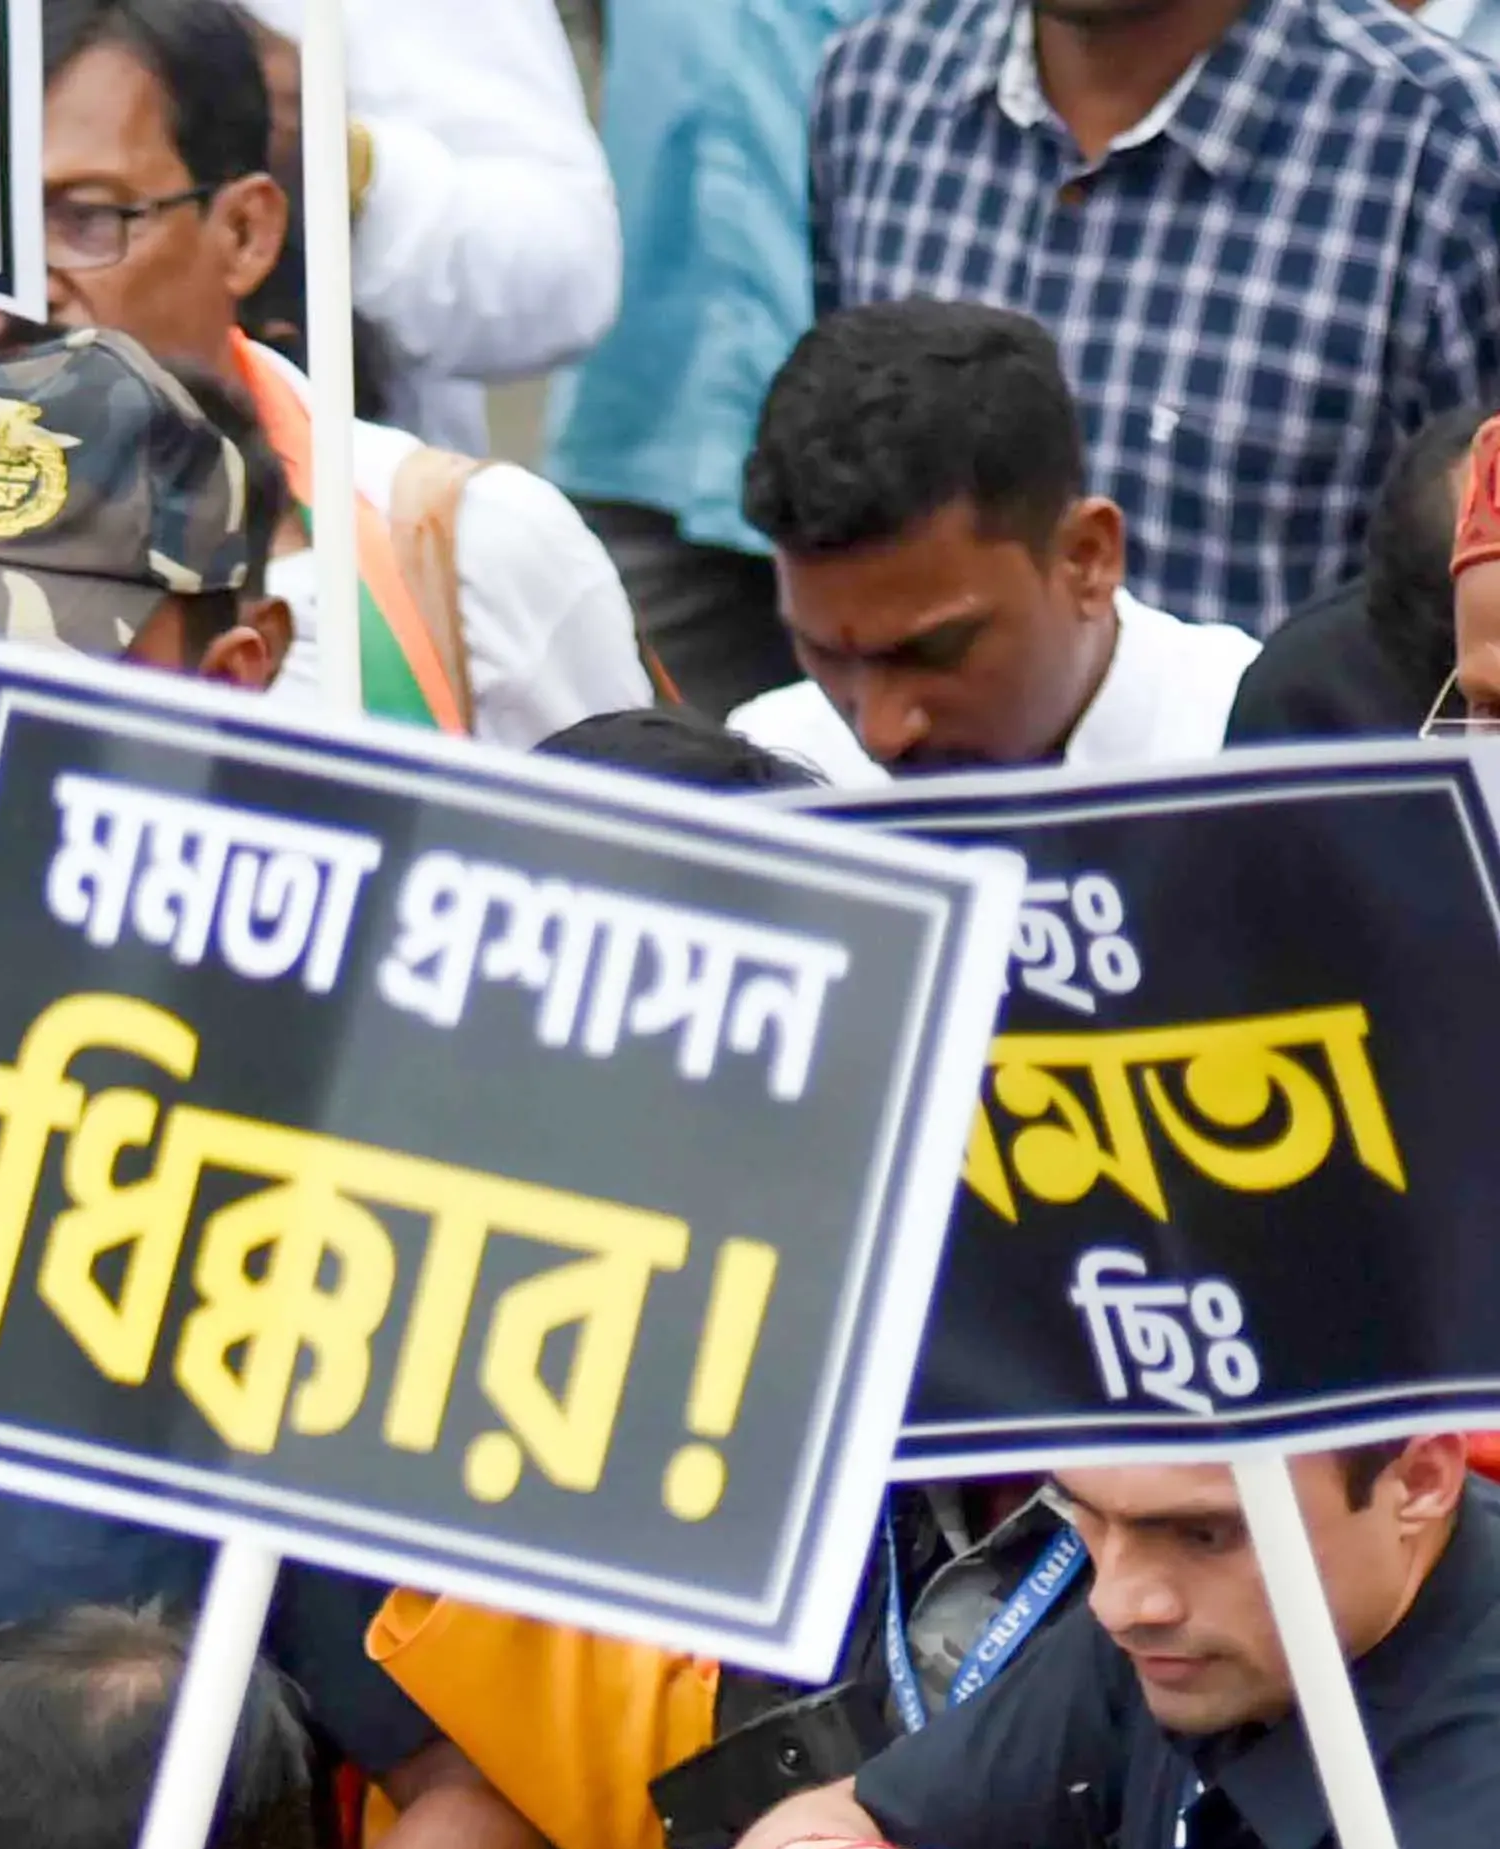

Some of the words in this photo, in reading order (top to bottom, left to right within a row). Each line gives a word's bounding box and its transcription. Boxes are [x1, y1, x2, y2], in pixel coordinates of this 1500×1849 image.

[44, 769, 382, 995] মমতা
[377, 846, 849, 1103] প্রশাসন
[1068, 1247, 1261, 1417] ছিঃ
[976, 1593, 1034, 1664] CRPF
